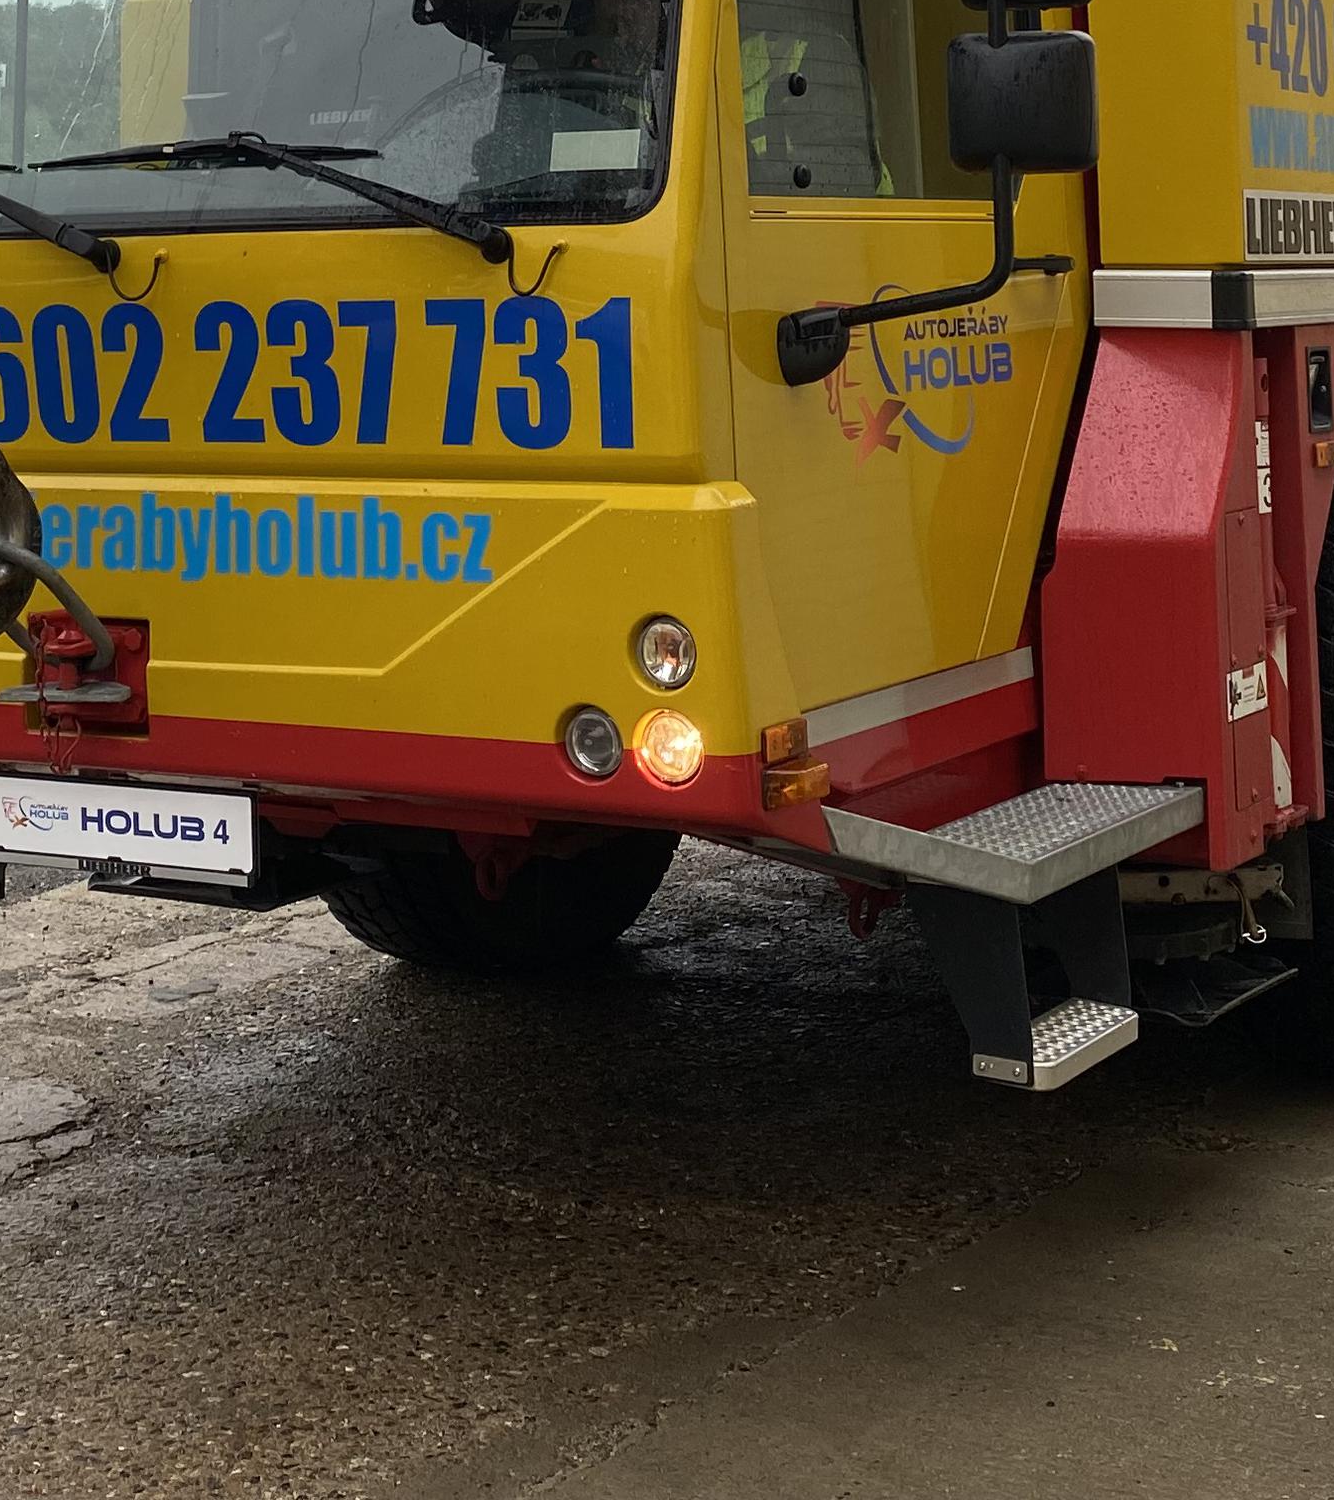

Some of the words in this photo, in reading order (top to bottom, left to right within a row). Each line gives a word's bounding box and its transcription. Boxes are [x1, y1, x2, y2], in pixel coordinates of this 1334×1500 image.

[903, 306, 1008, 340] AUTOJEŘÁBY
[194, 299, 398, 445] 237
[425, 296, 634, 449] 731
[904, 342, 1013, 391] HOLUB
[30, 808, 69, 821] HOLUB
[81, 807, 204, 841] HOLUB
[213, 819, 229, 844] 4
